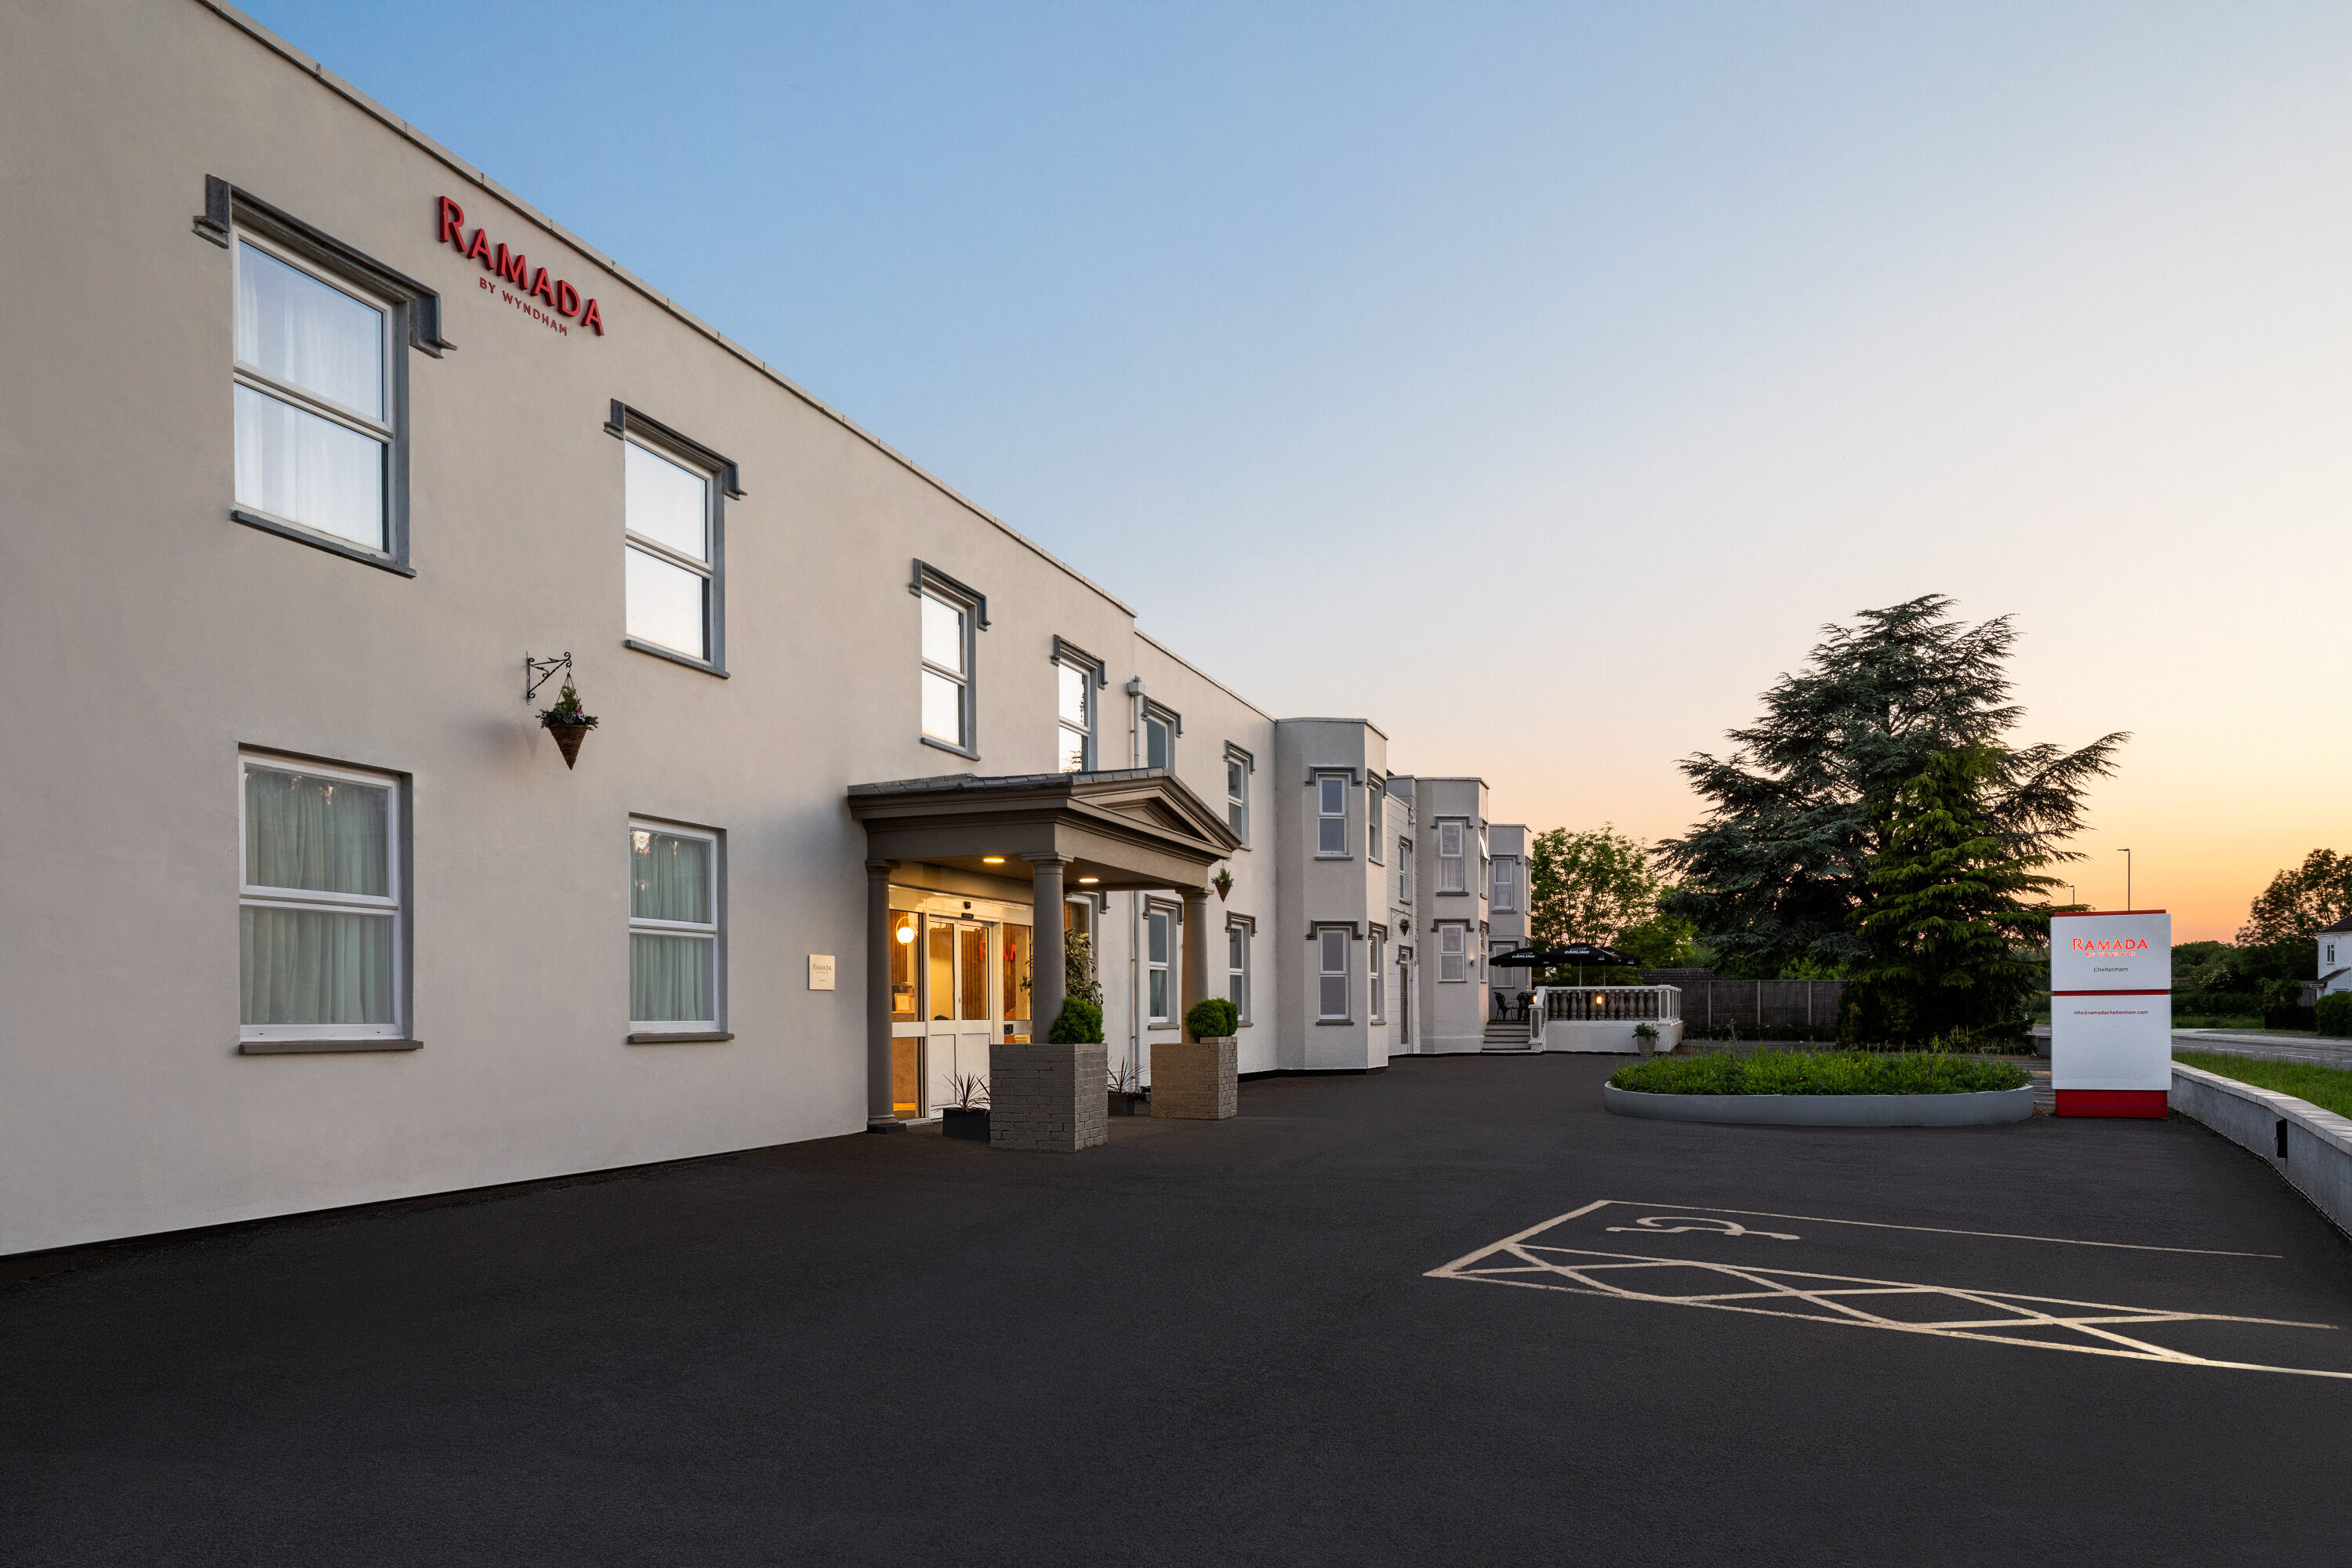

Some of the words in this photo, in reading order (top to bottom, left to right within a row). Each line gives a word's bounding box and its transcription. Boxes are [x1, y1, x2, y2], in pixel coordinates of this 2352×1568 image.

[438, 195, 604, 336] RAMADA
[480, 277, 495, 294] BY
[503, 290, 568, 336] WYNDHAM
[2072, 938, 2148, 951] RAMADA
